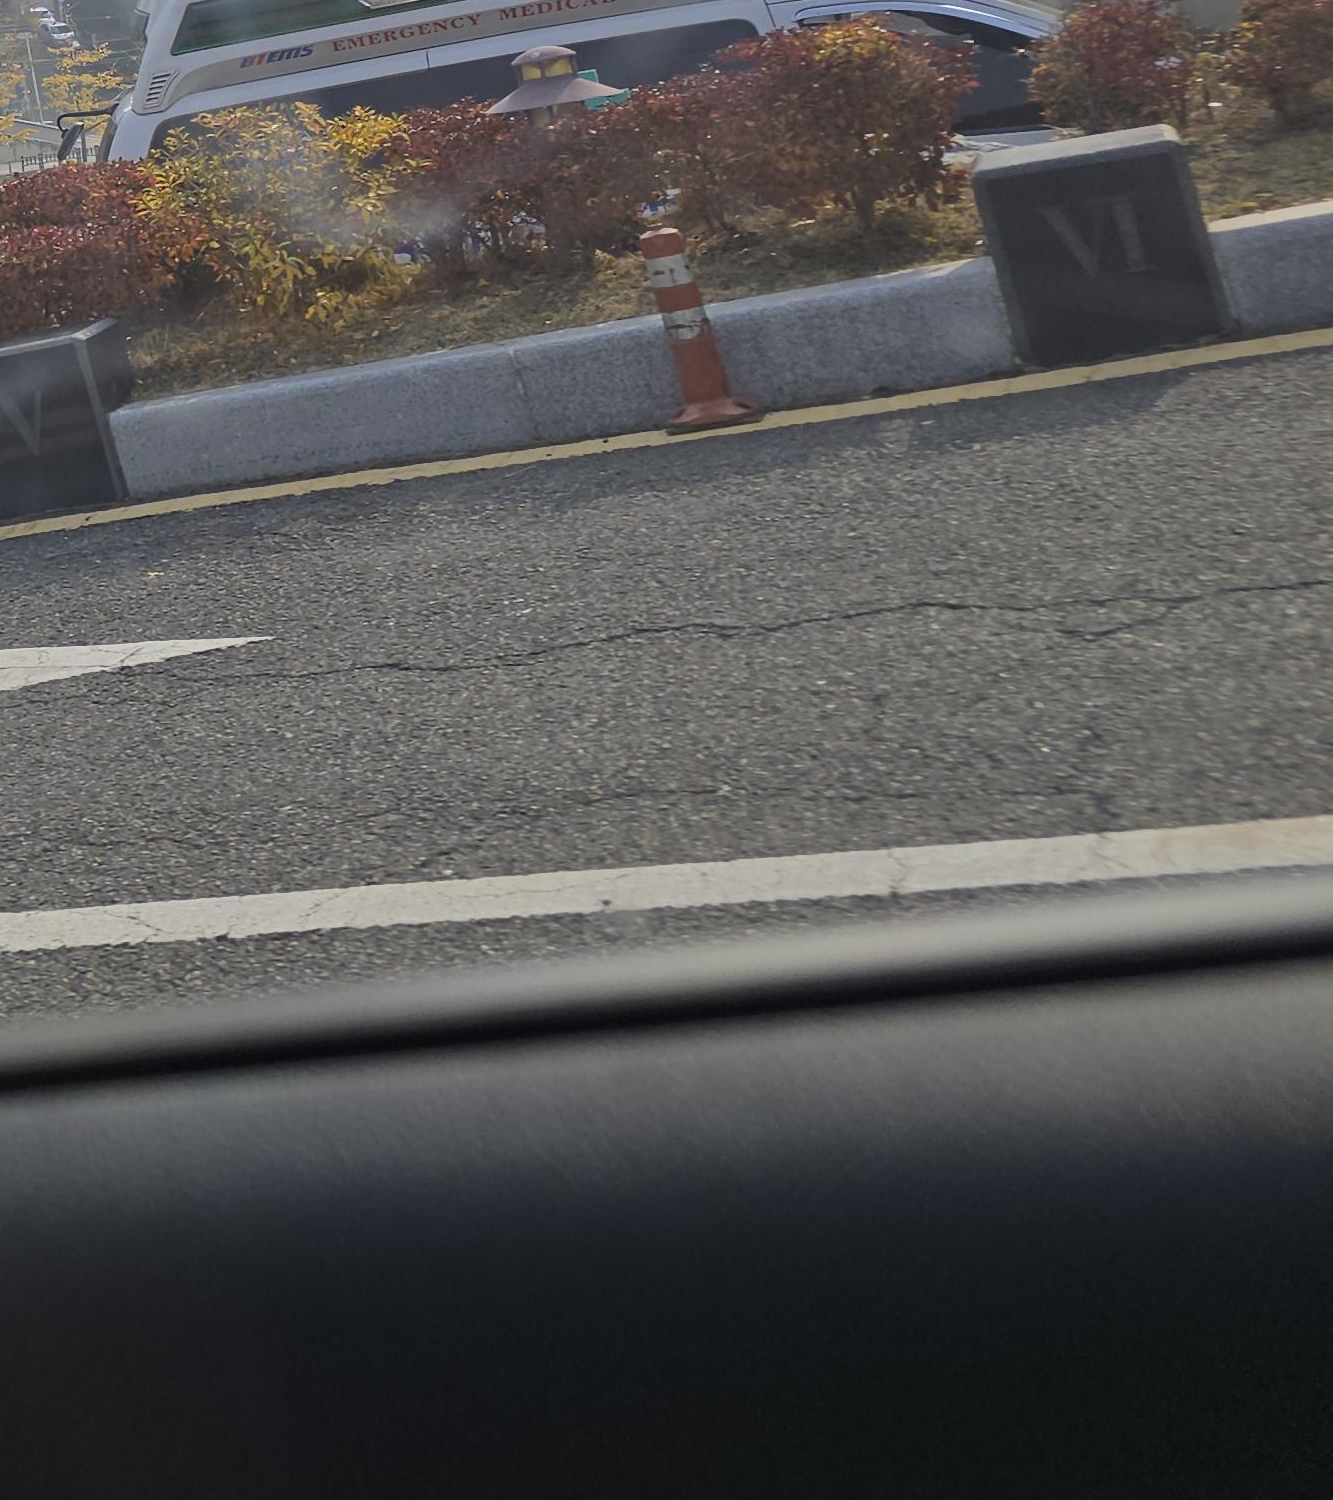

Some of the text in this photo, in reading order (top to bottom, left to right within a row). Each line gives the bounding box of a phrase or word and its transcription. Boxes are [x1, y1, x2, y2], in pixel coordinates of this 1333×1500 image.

[331, 12, 482, 53] EMERGENCY
[1034, 192, 1158, 278] VI
[0, 387, 45, 457] V
